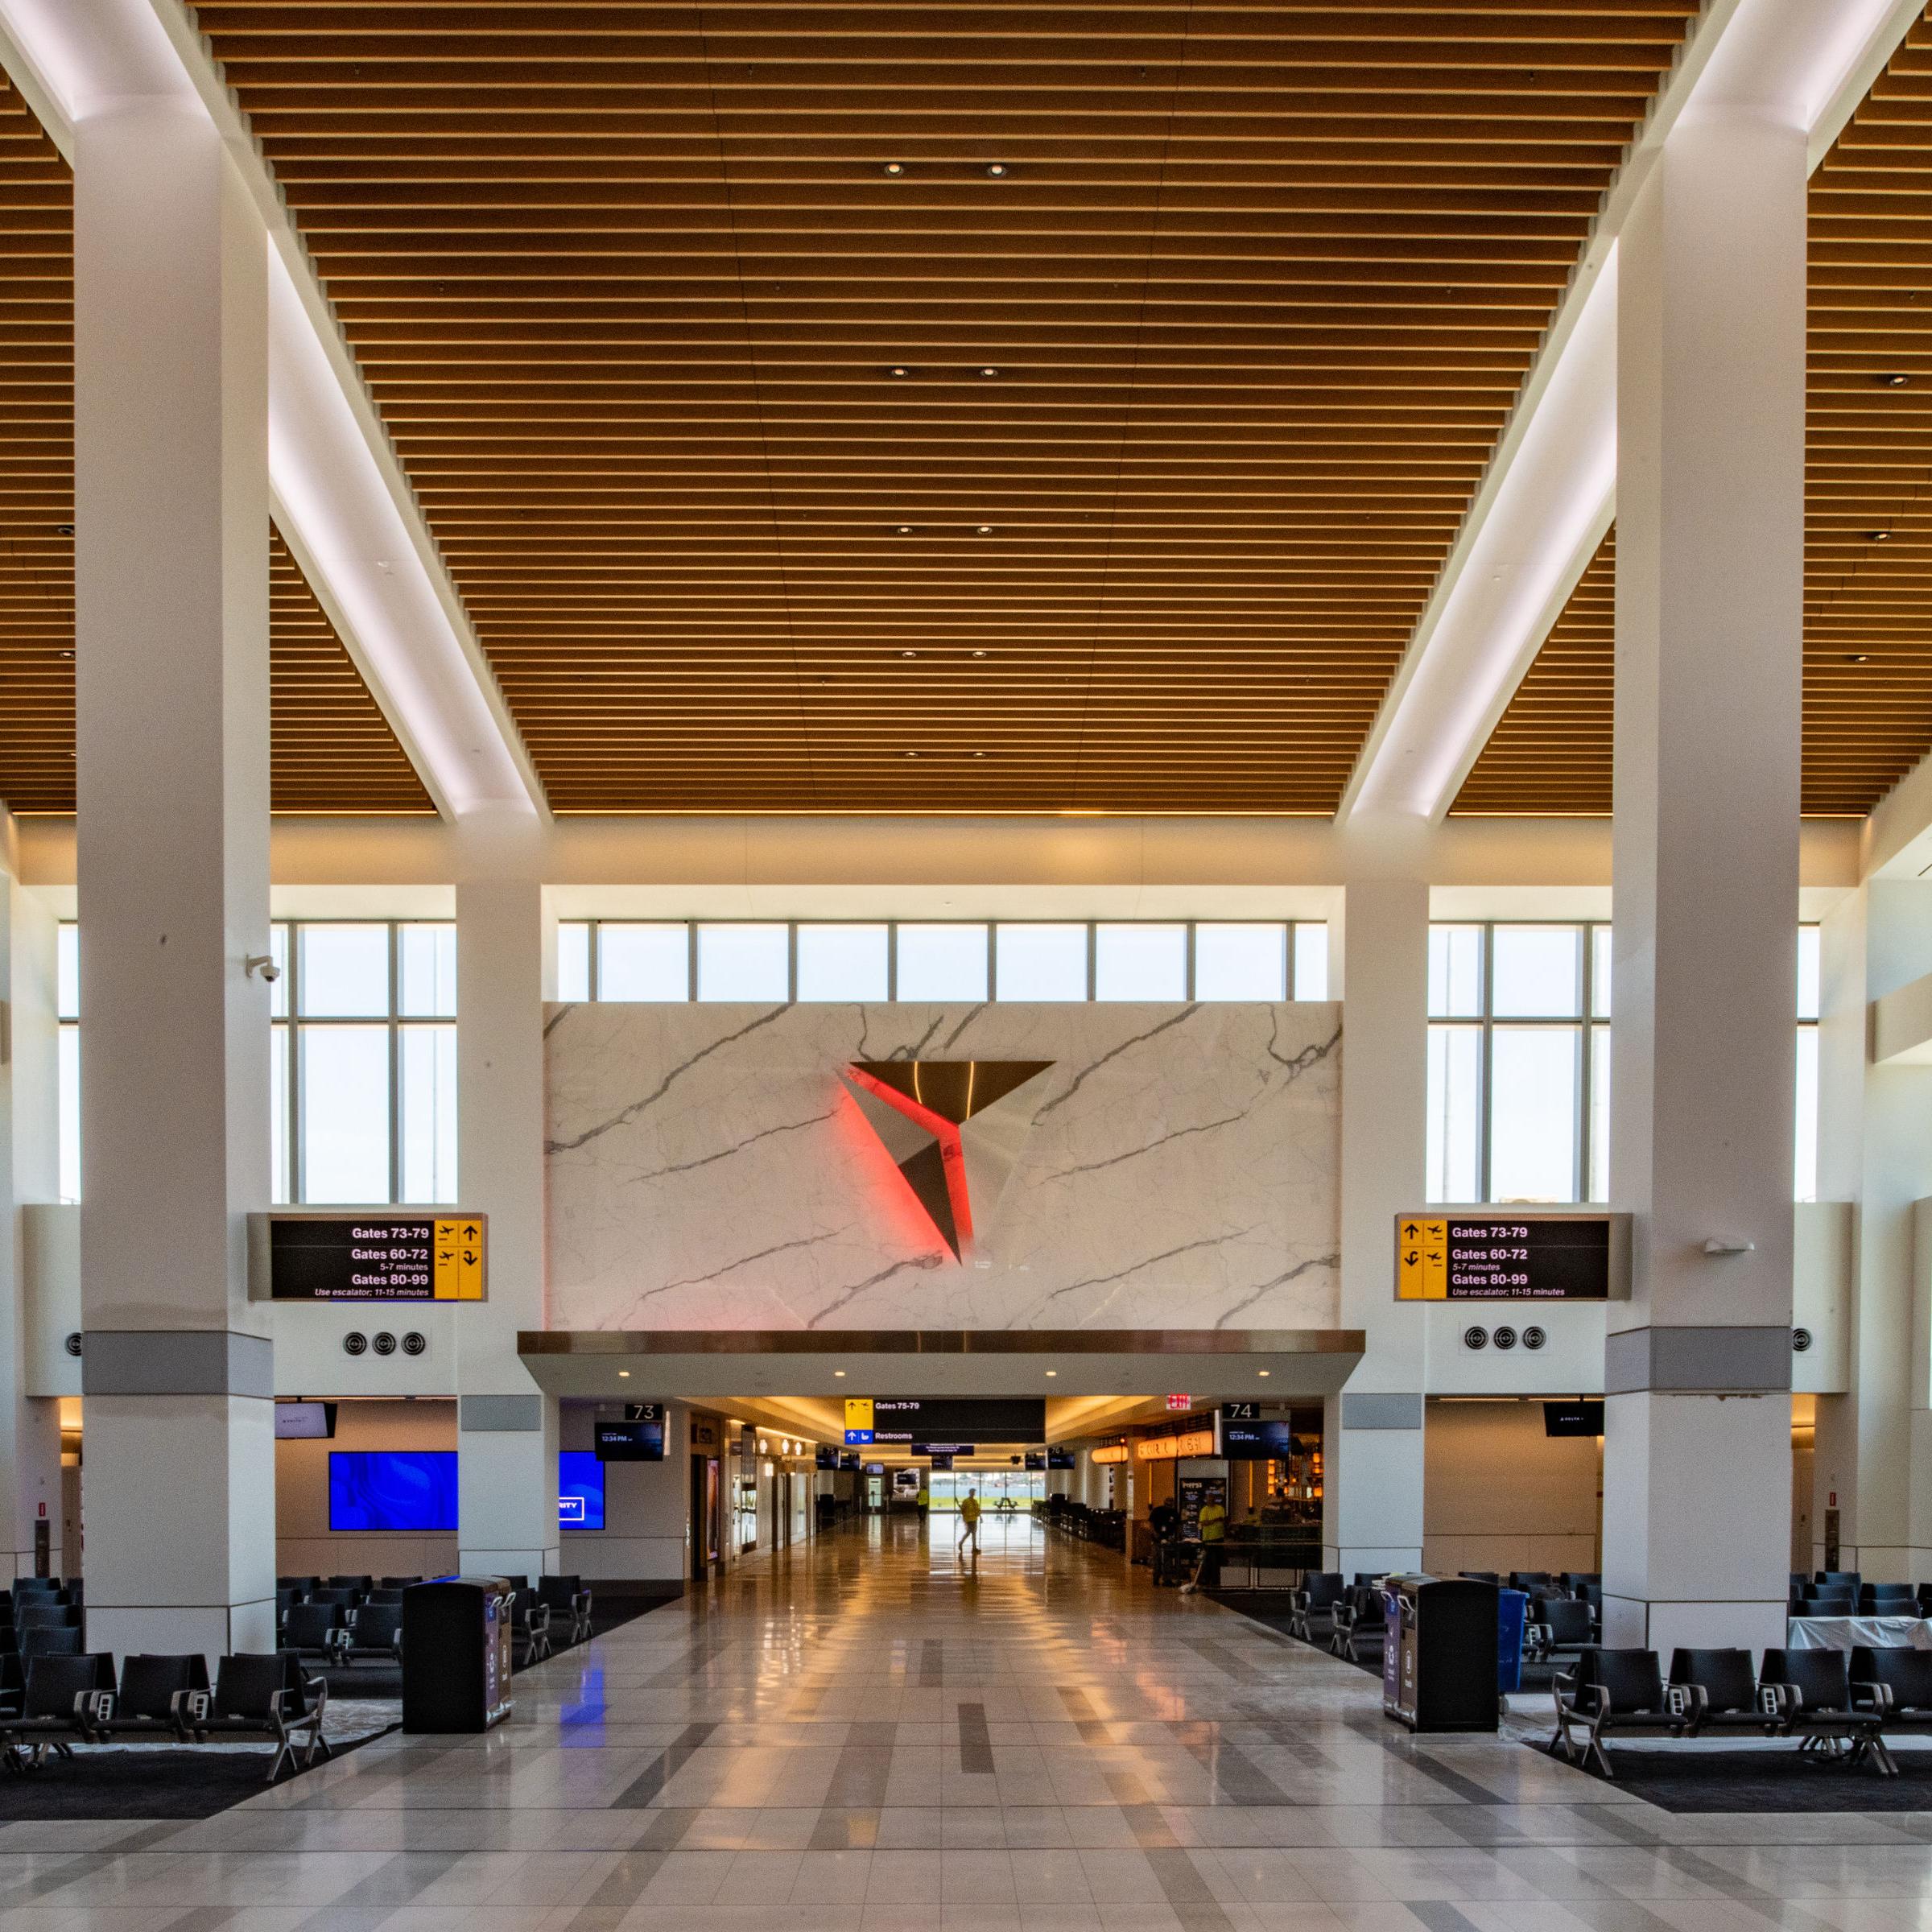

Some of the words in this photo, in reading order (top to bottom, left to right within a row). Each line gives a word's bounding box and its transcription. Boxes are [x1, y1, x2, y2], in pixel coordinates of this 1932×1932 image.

[352, 1228, 388, 1239] Gates
[390, 1228, 430, 1239] 73-79
[1452, 1227, 1487, 1238] Gates
[1490, 1227, 1528, 1238] 73-79
[351, 1249, 387, 1260] Gates
[390, 1249, 428, 1260] 60-72
[1452, 1249, 1487, 1260] Gates
[1490, 1249, 1528, 1260] 60-72
[379, 1263, 394, 1271] 5-7
[396, 1263, 428, 1271] minutes
[1452, 1263, 1467, 1271] 5-7
[1468, 1263, 1501, 1271] minutes
[351, 1274, 387, 1285] Gates
[390, 1274, 429, 1285] 80-99
[1452, 1274, 1487, 1285] Gates
[1490, 1274, 1528, 1285] 80-99
[315, 1288, 330, 1296] Use
[332, 1288, 373, 1297] escalator;
[374, 1288, 395, 1296] 11-15
[396, 1288, 429, 1296] minutes
[1452, 1288, 1468, 1296] Use
[1469, 1288, 1509, 1297] escalator;
[1511, 1288, 1531, 1296] 11-15
[1533, 1288, 1565, 1296] minutes
[634, 1405, 654, 1419] 73
[1230, 1404, 1252, 1418] 74
